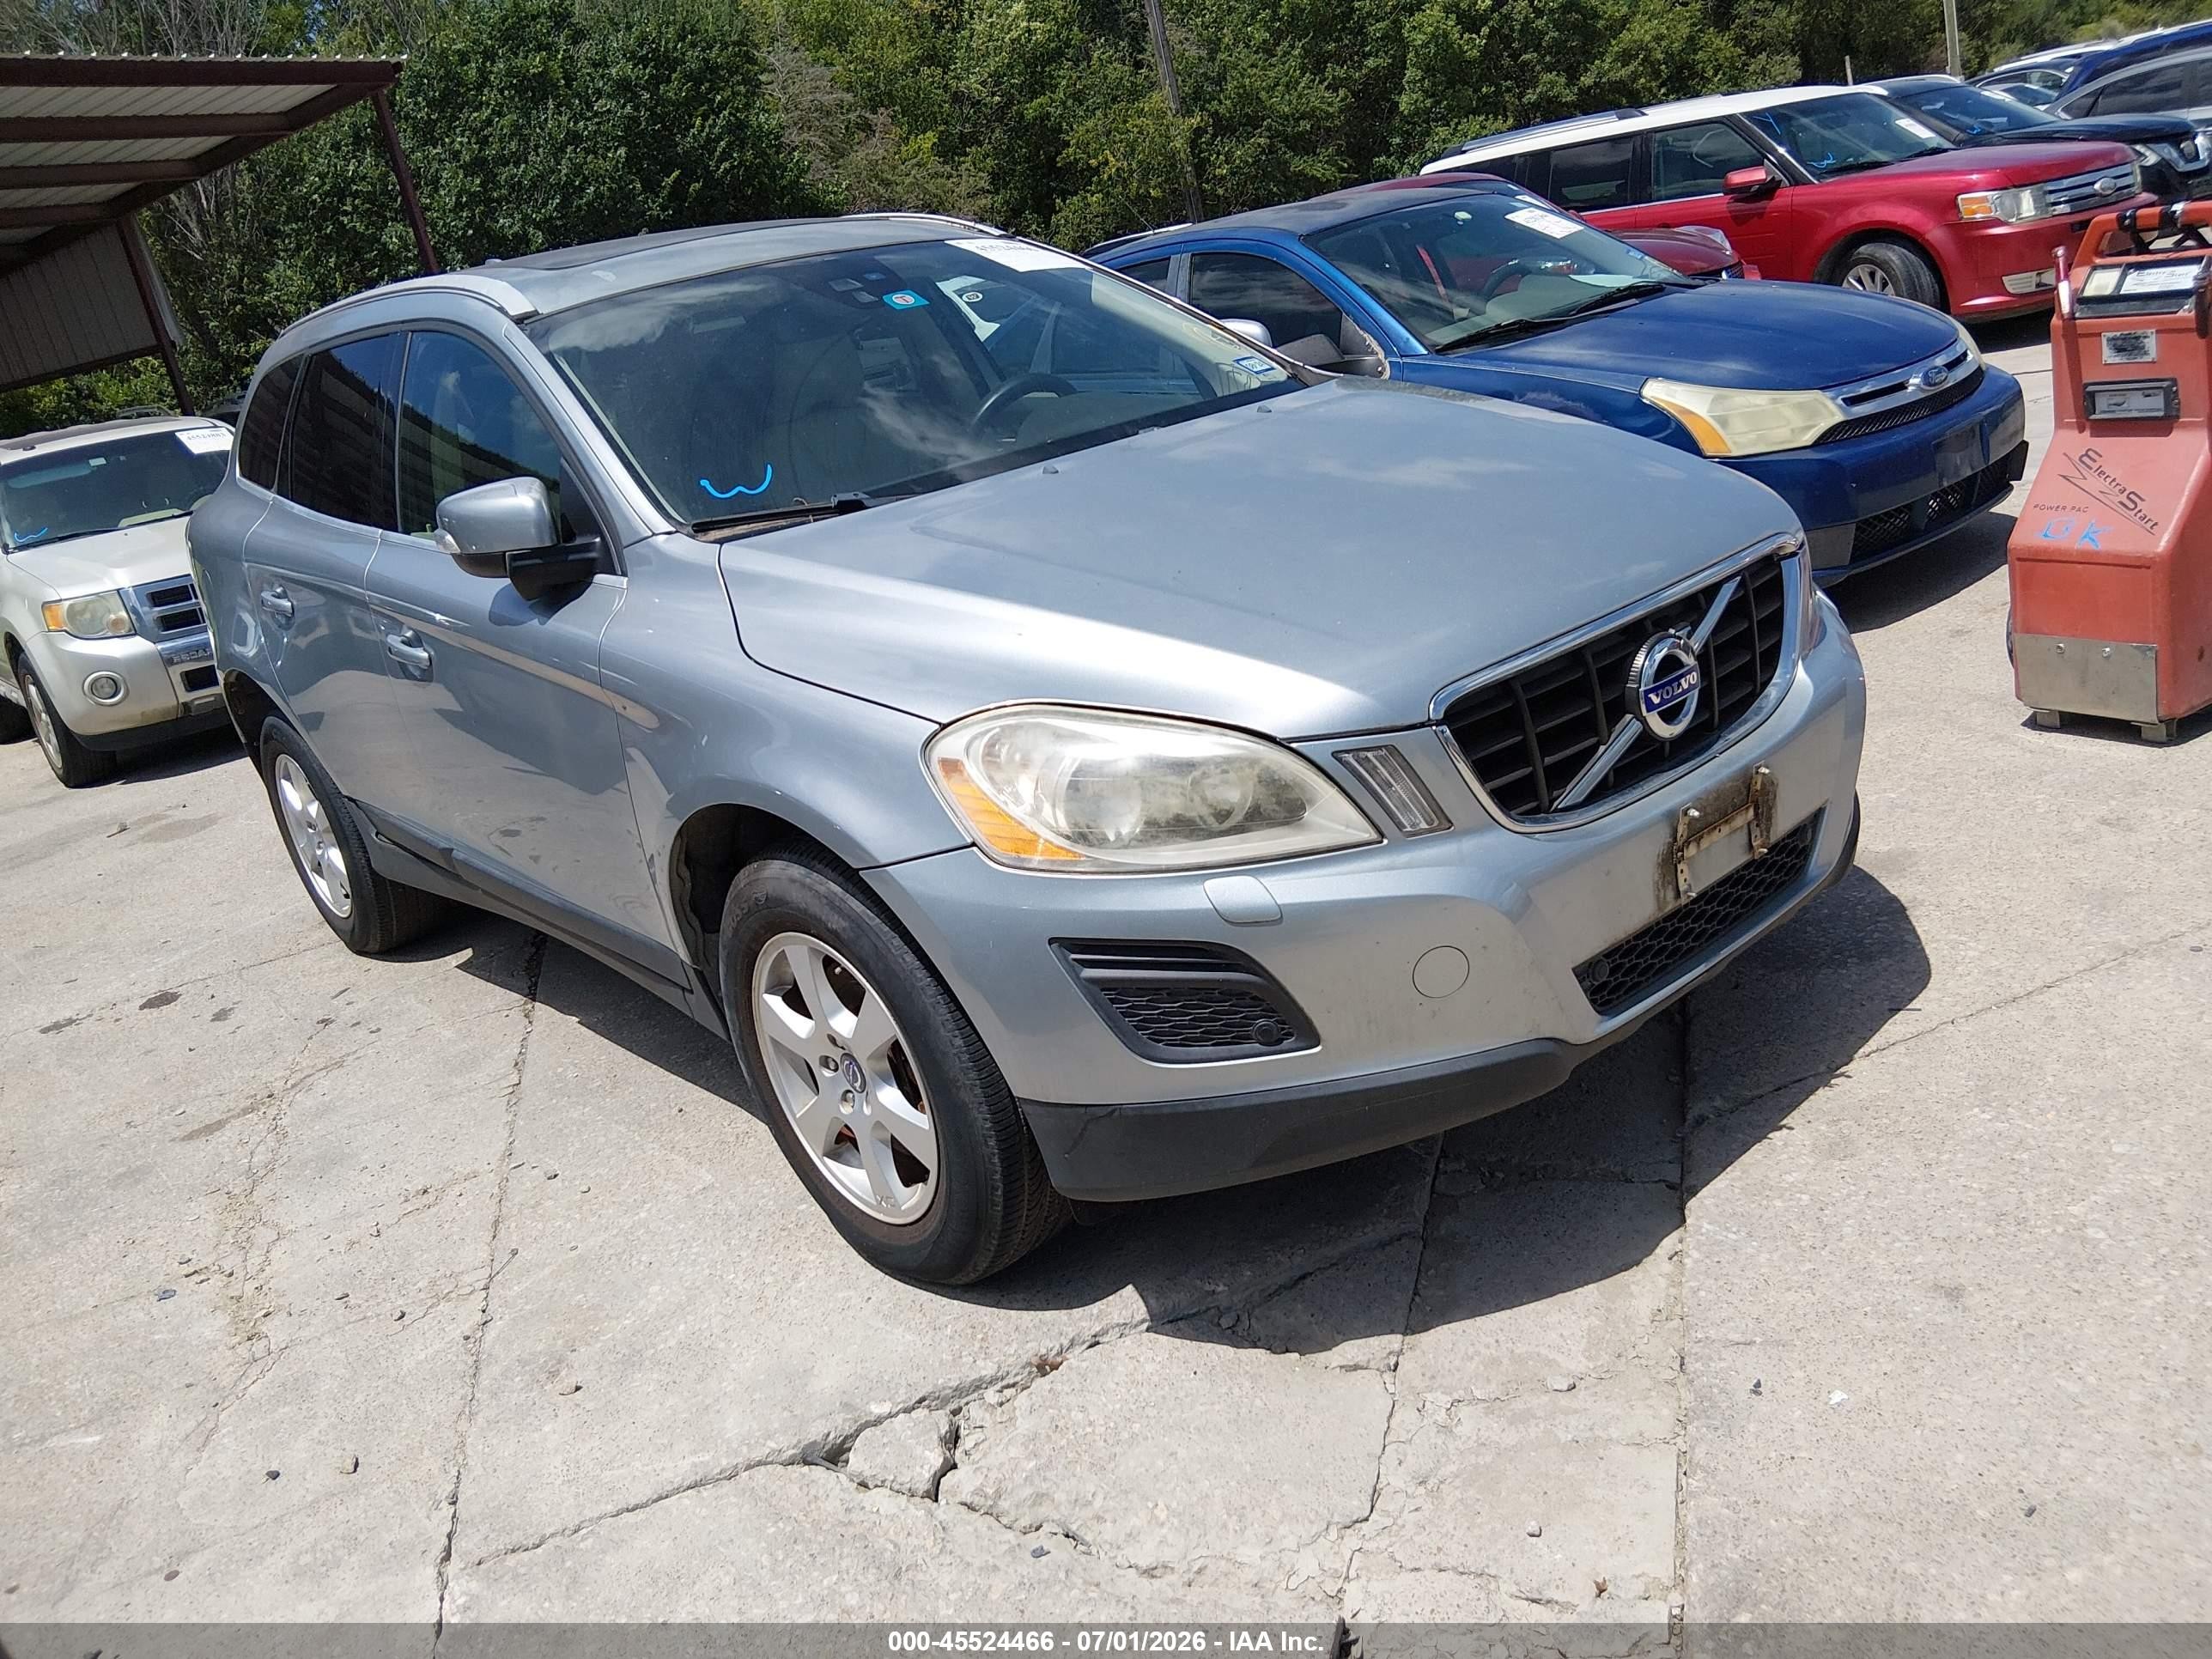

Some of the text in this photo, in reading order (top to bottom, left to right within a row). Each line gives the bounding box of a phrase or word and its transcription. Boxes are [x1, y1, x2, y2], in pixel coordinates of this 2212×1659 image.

[2078, 447, 2127, 495] Electra
[2117, 490, 2160, 531] Start
[2033, 503, 2068, 512] POWER
[1648, 672, 1698, 704] VOLVO
